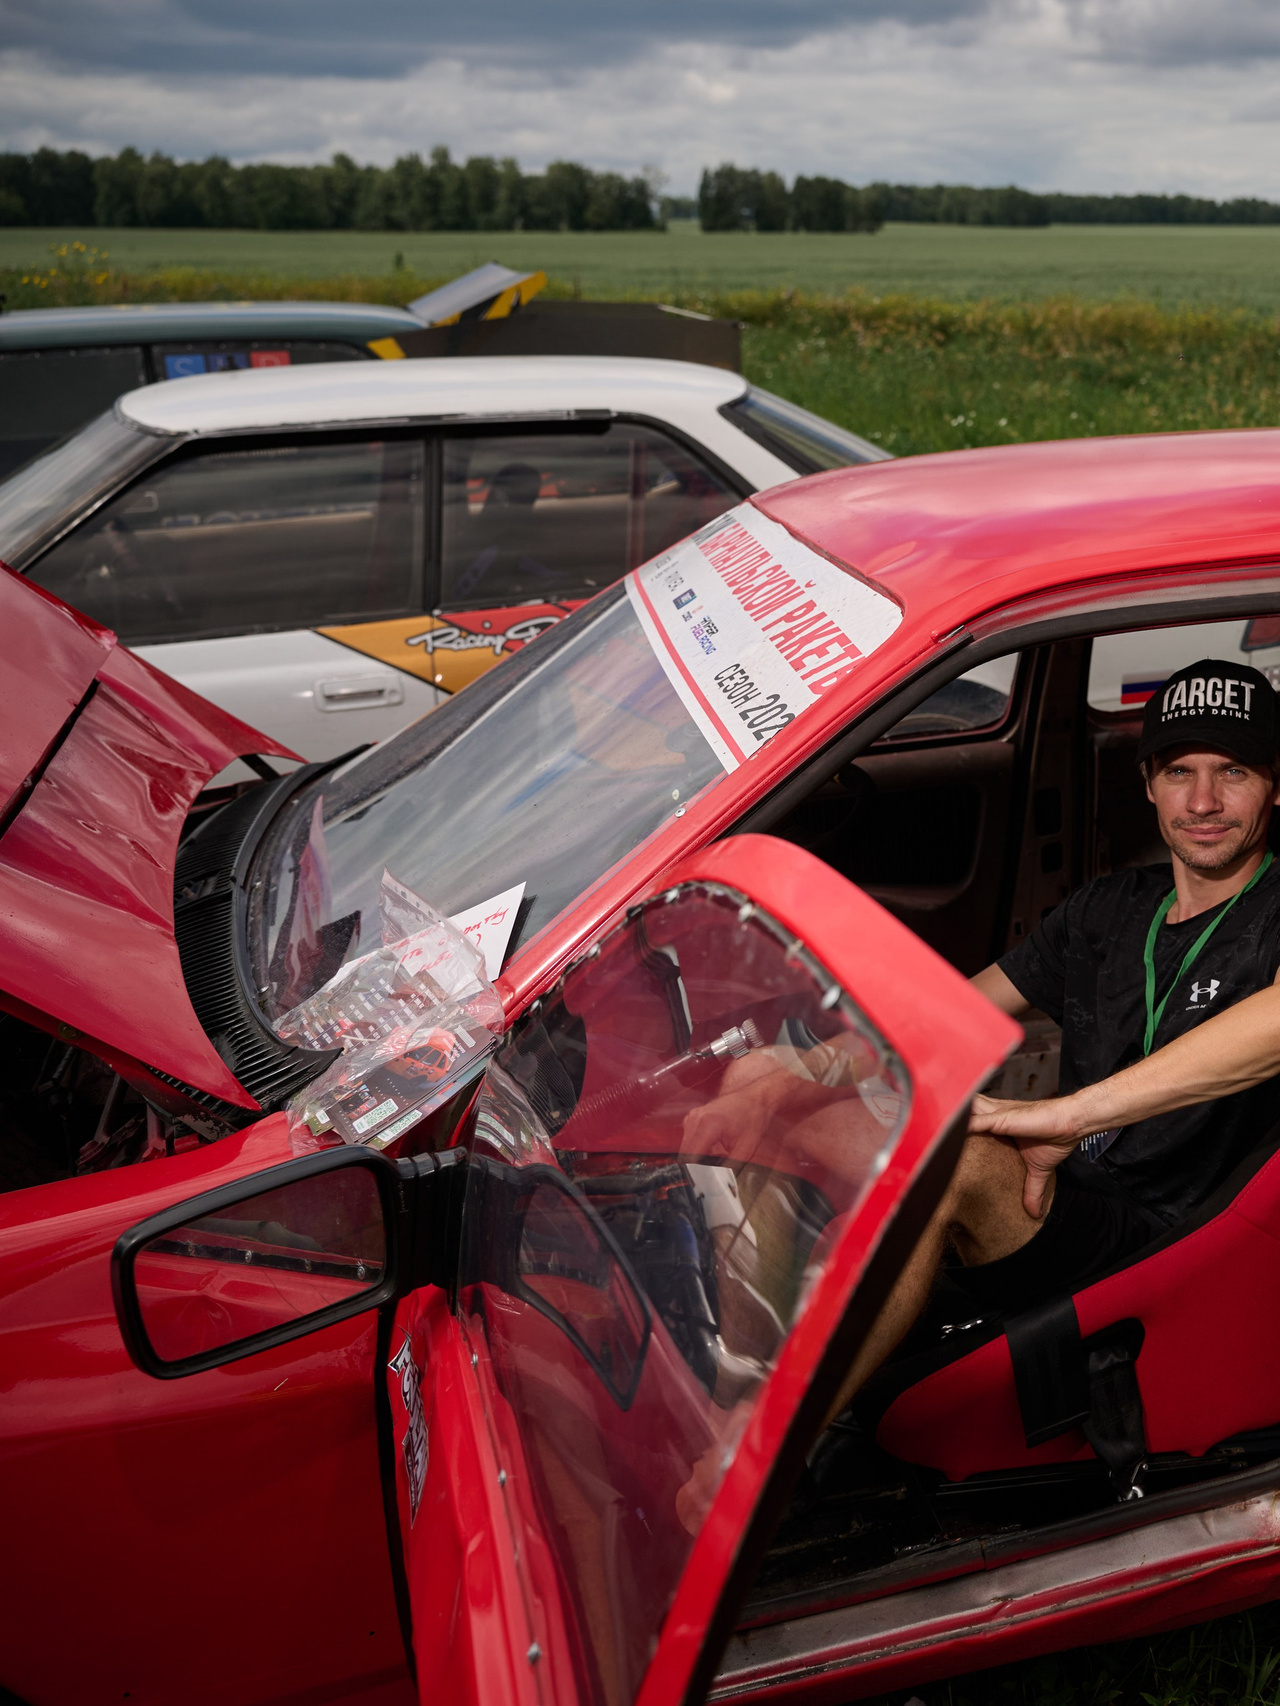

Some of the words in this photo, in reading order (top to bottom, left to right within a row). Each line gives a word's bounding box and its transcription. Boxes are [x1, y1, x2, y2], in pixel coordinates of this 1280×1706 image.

[698, 522, 813, 621] БАРНАУЛЬСКОЙ
[713, 662, 762, 709] СЕЗОН
[738, 693, 798, 744] 202
[1161, 707, 1204, 723] ENERGY
[1211, 708, 1251, 721] DRINK
[1162, 676, 1256, 713] TARGET
